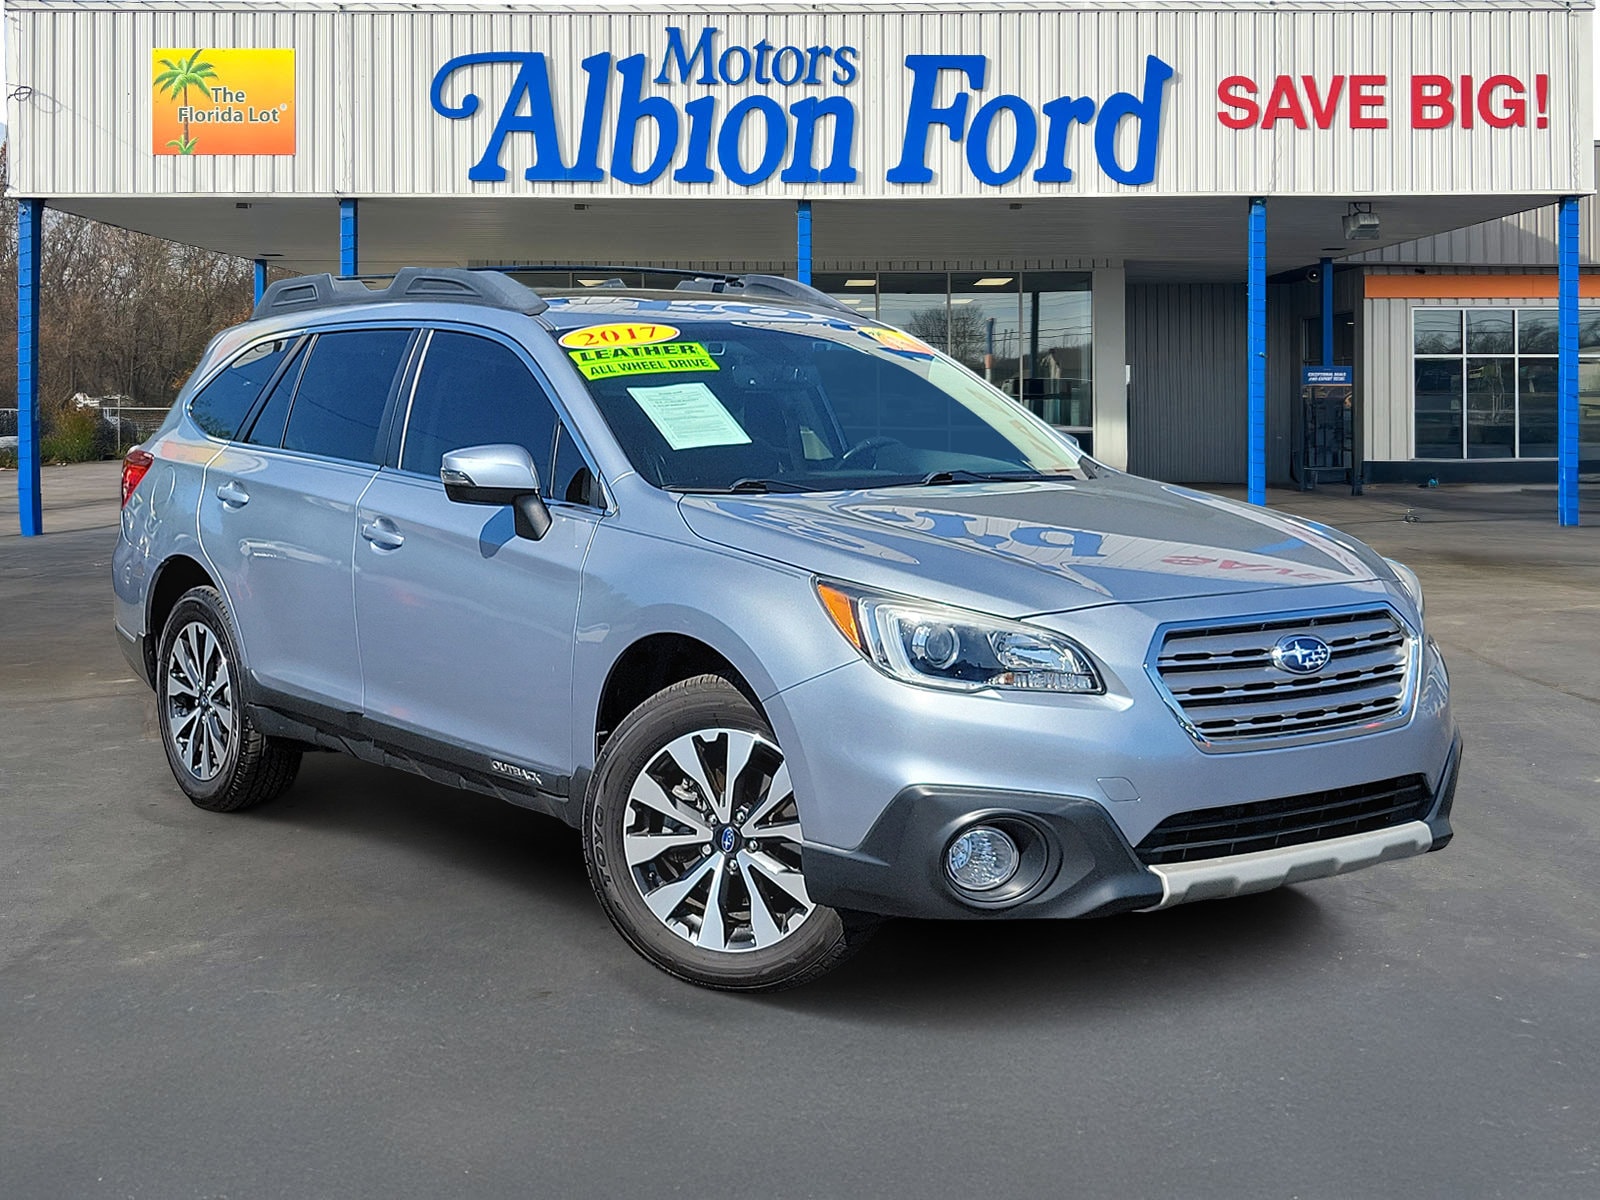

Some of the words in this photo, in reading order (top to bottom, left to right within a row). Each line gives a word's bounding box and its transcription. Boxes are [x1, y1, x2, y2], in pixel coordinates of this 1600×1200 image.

[655, 27, 856, 86] Motors
[211, 86, 245, 103] The
[1217, 74, 1388, 130] SAVE
[1410, 74, 1548, 130] BIG!
[178, 106, 243, 122] Florida
[249, 107, 279, 122] Lot
[430, 51, 857, 187] Albion
[886, 55, 1174, 187] Ford
[578, 325, 656, 347] 2017
[580, 344, 698, 362] LEATHER
[590, 363, 617, 376] ALL
[619, 359, 667, 373] WHEEL
[669, 358, 710, 370] DRIVE
[492, 760, 543, 786] OUTBACK
[592, 804, 612, 887] TOYO
